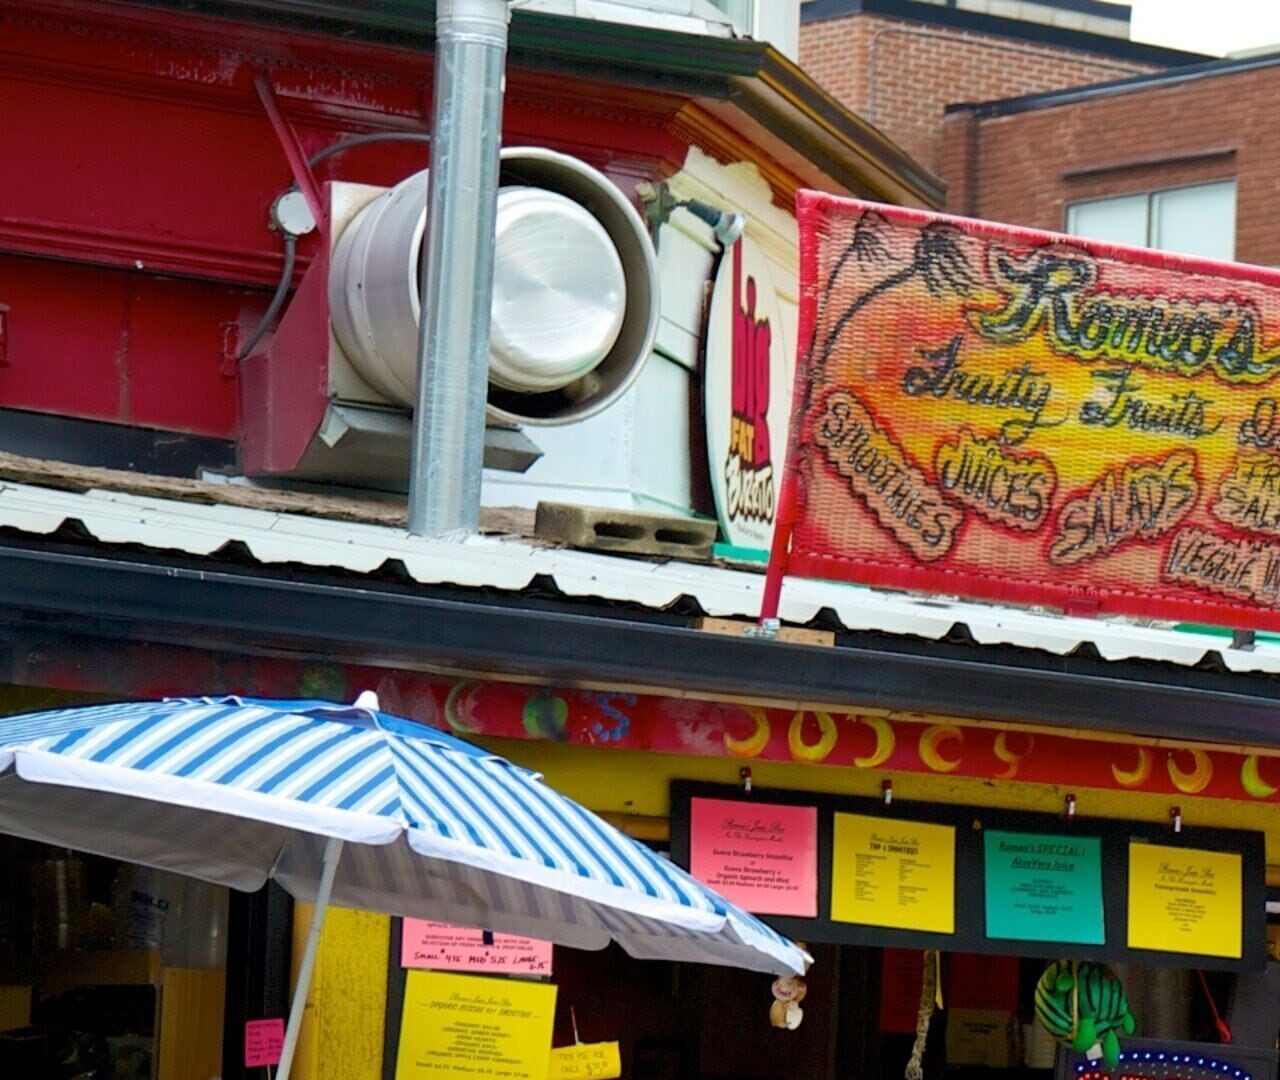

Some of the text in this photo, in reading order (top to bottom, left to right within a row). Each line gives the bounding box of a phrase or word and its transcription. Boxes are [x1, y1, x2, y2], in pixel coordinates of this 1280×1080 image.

[902, 334, 1067, 445] Fruity
[823, 397, 952, 550] SMOOTHIES
[941, 439, 1046, 521] JUICES
[1059, 460, 1198, 552] SALADS
[1167, 531, 1258, 592] VEGGIE
